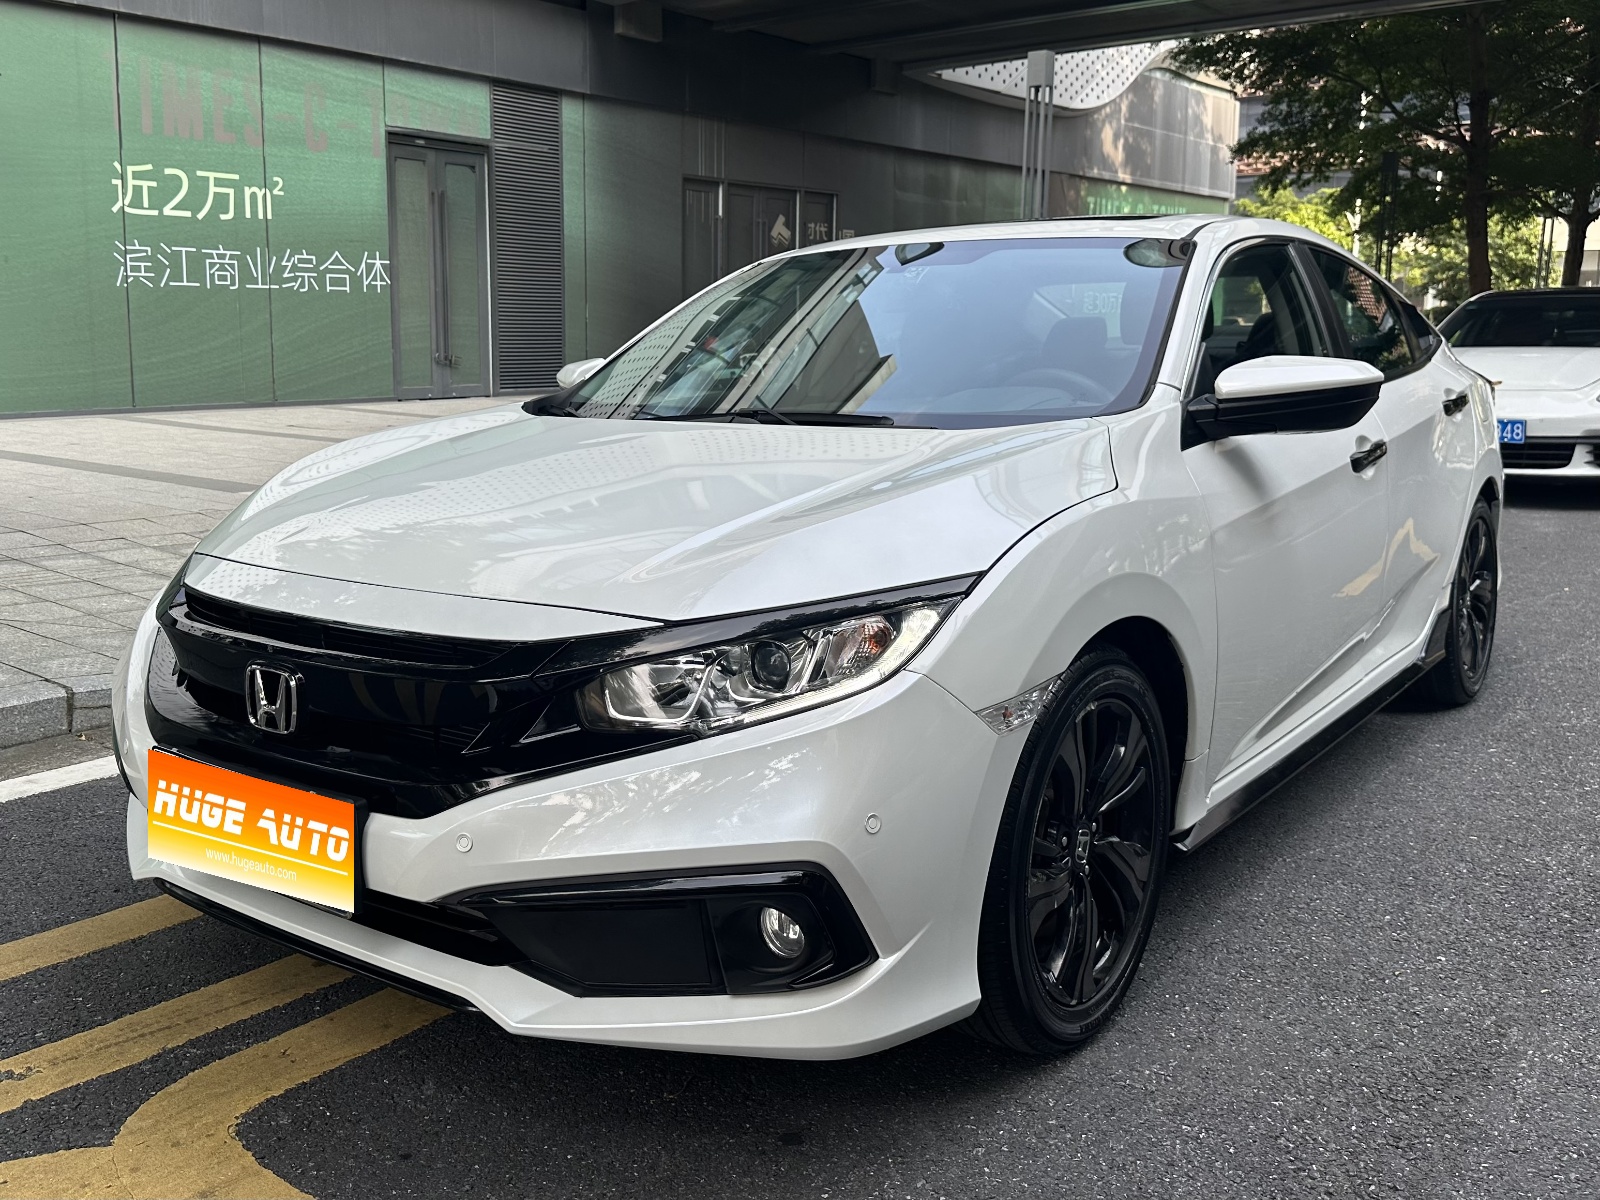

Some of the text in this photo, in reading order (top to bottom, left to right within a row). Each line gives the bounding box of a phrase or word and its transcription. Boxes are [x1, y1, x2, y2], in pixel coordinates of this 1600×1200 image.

[113, 239, 391, 293] 滨江商业综合体
